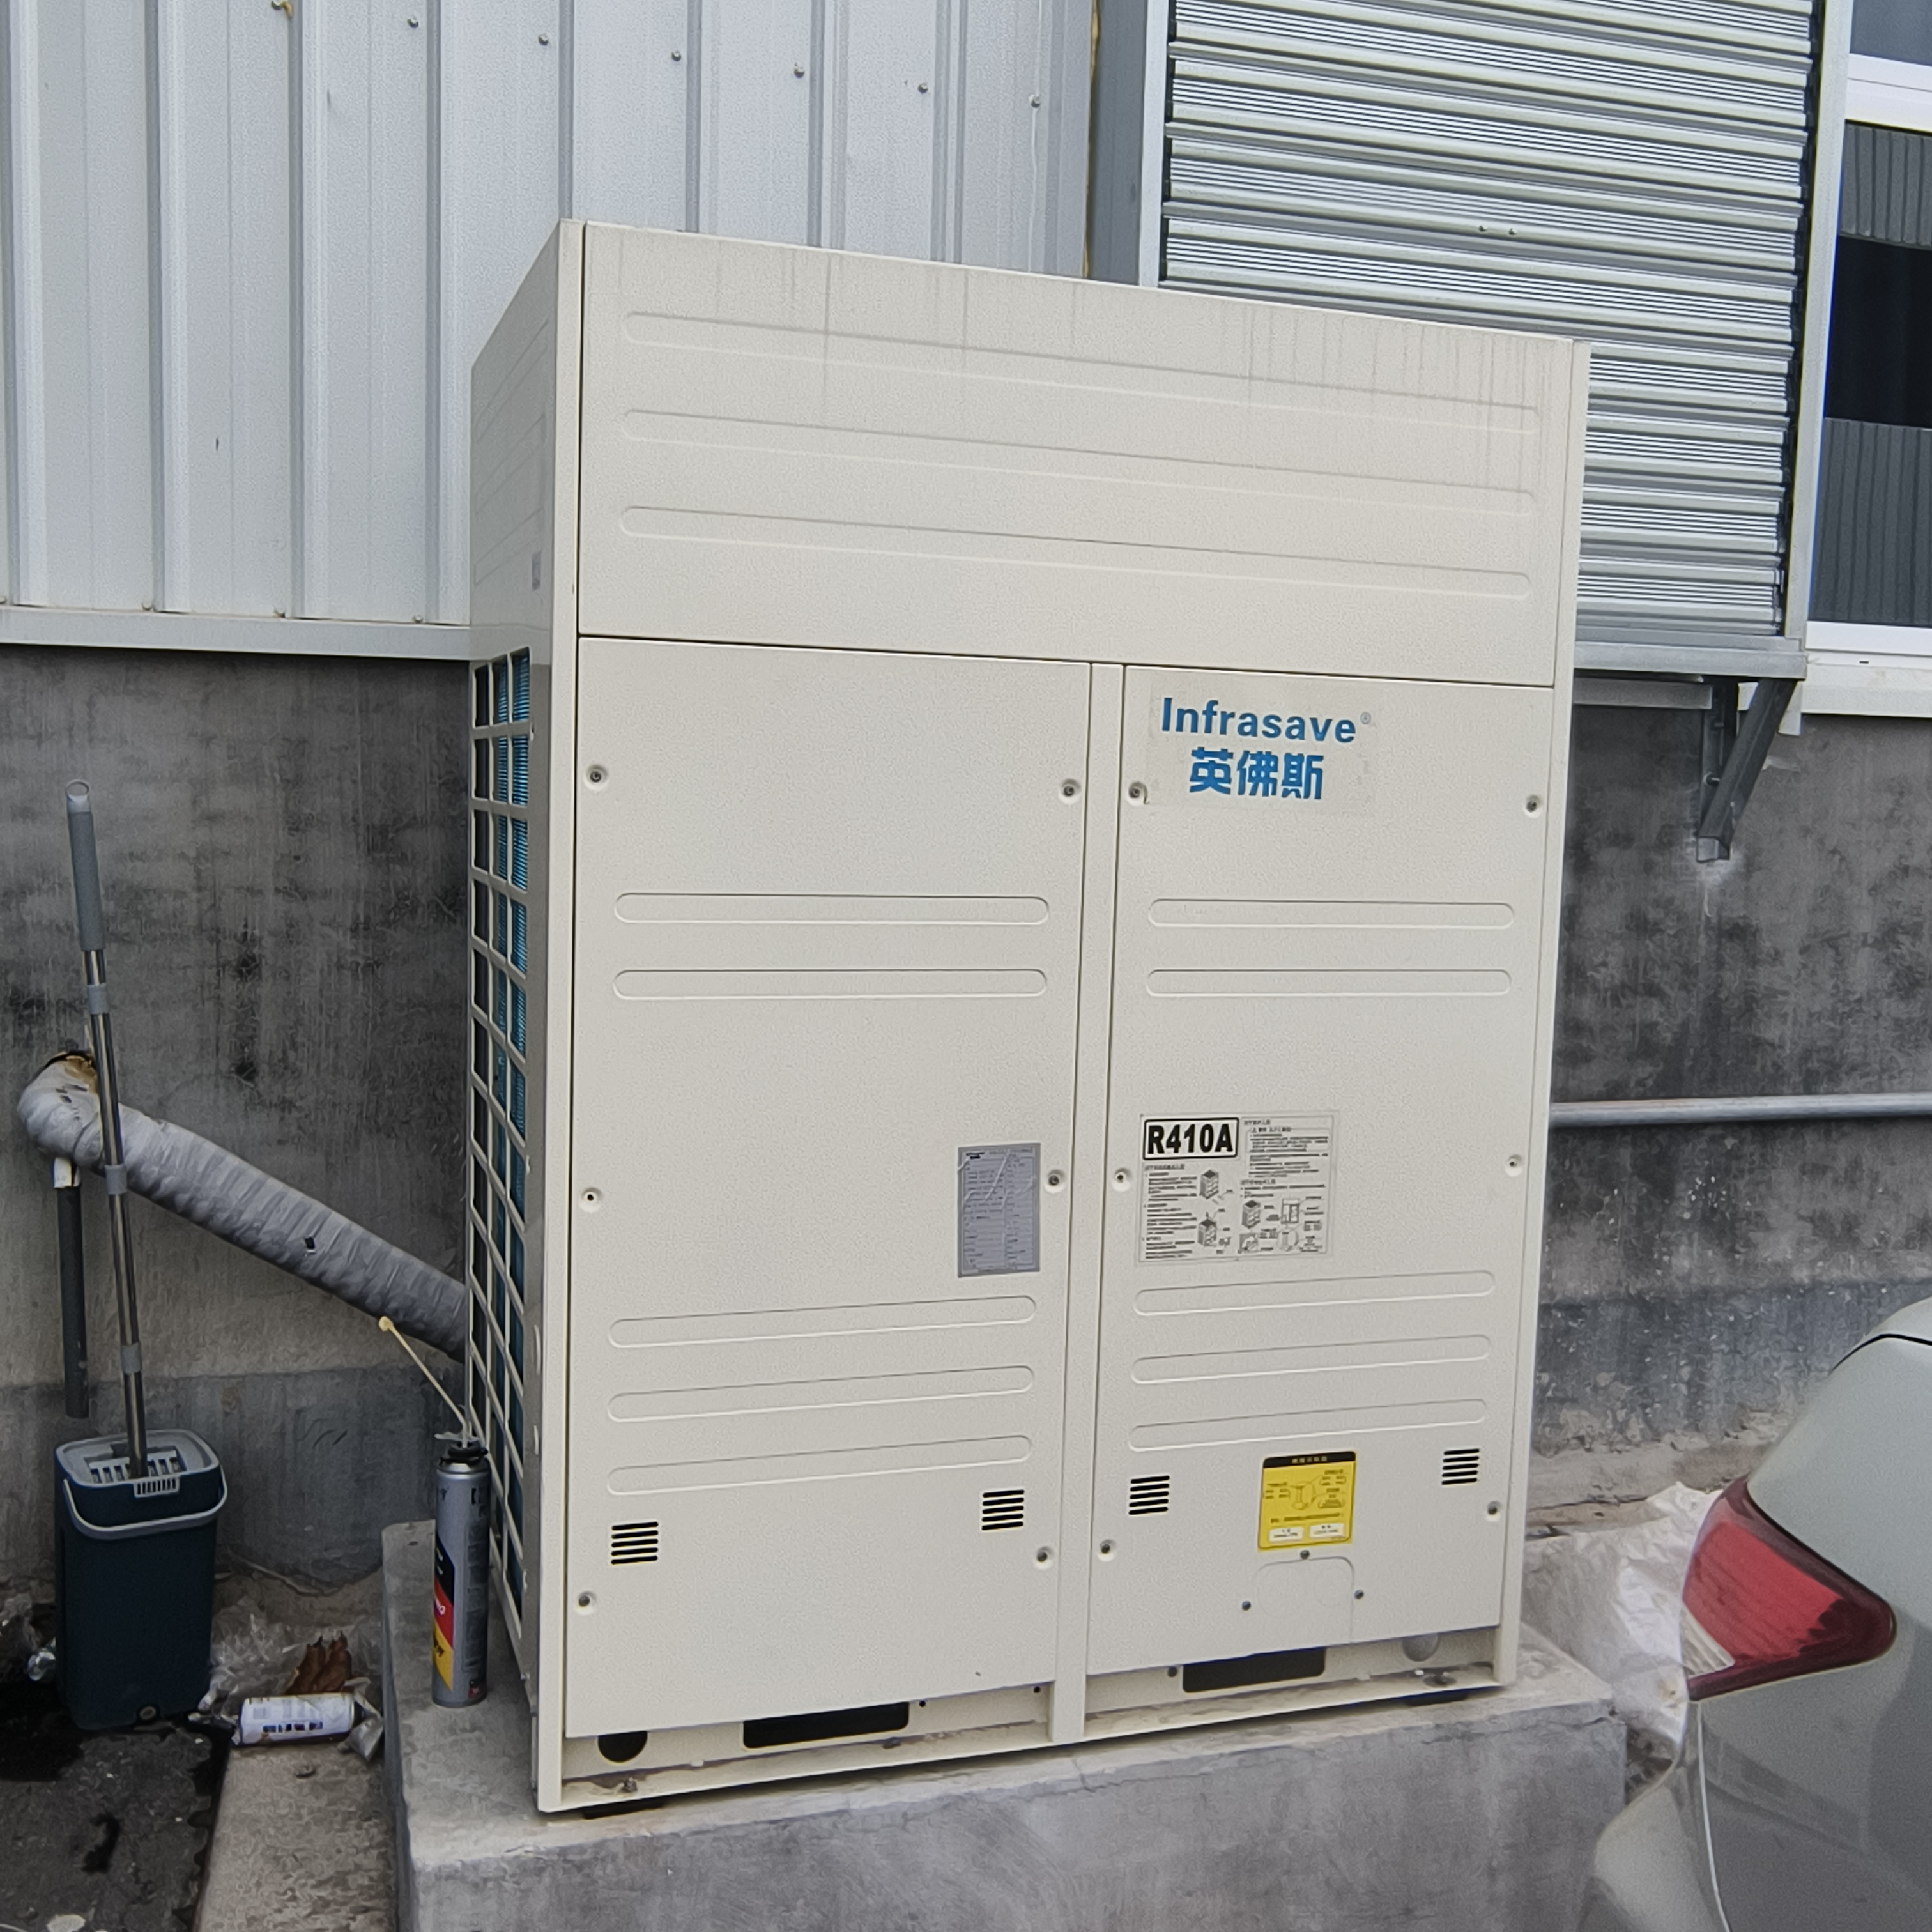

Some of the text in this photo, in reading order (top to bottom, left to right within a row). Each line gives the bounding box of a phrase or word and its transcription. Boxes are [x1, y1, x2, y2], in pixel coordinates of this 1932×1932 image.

[1162, 698, 1356, 743] Infrasave
[1189, 746, 1324, 800] 英佛斯
[1147, 1123, 1233, 1154] R410A
